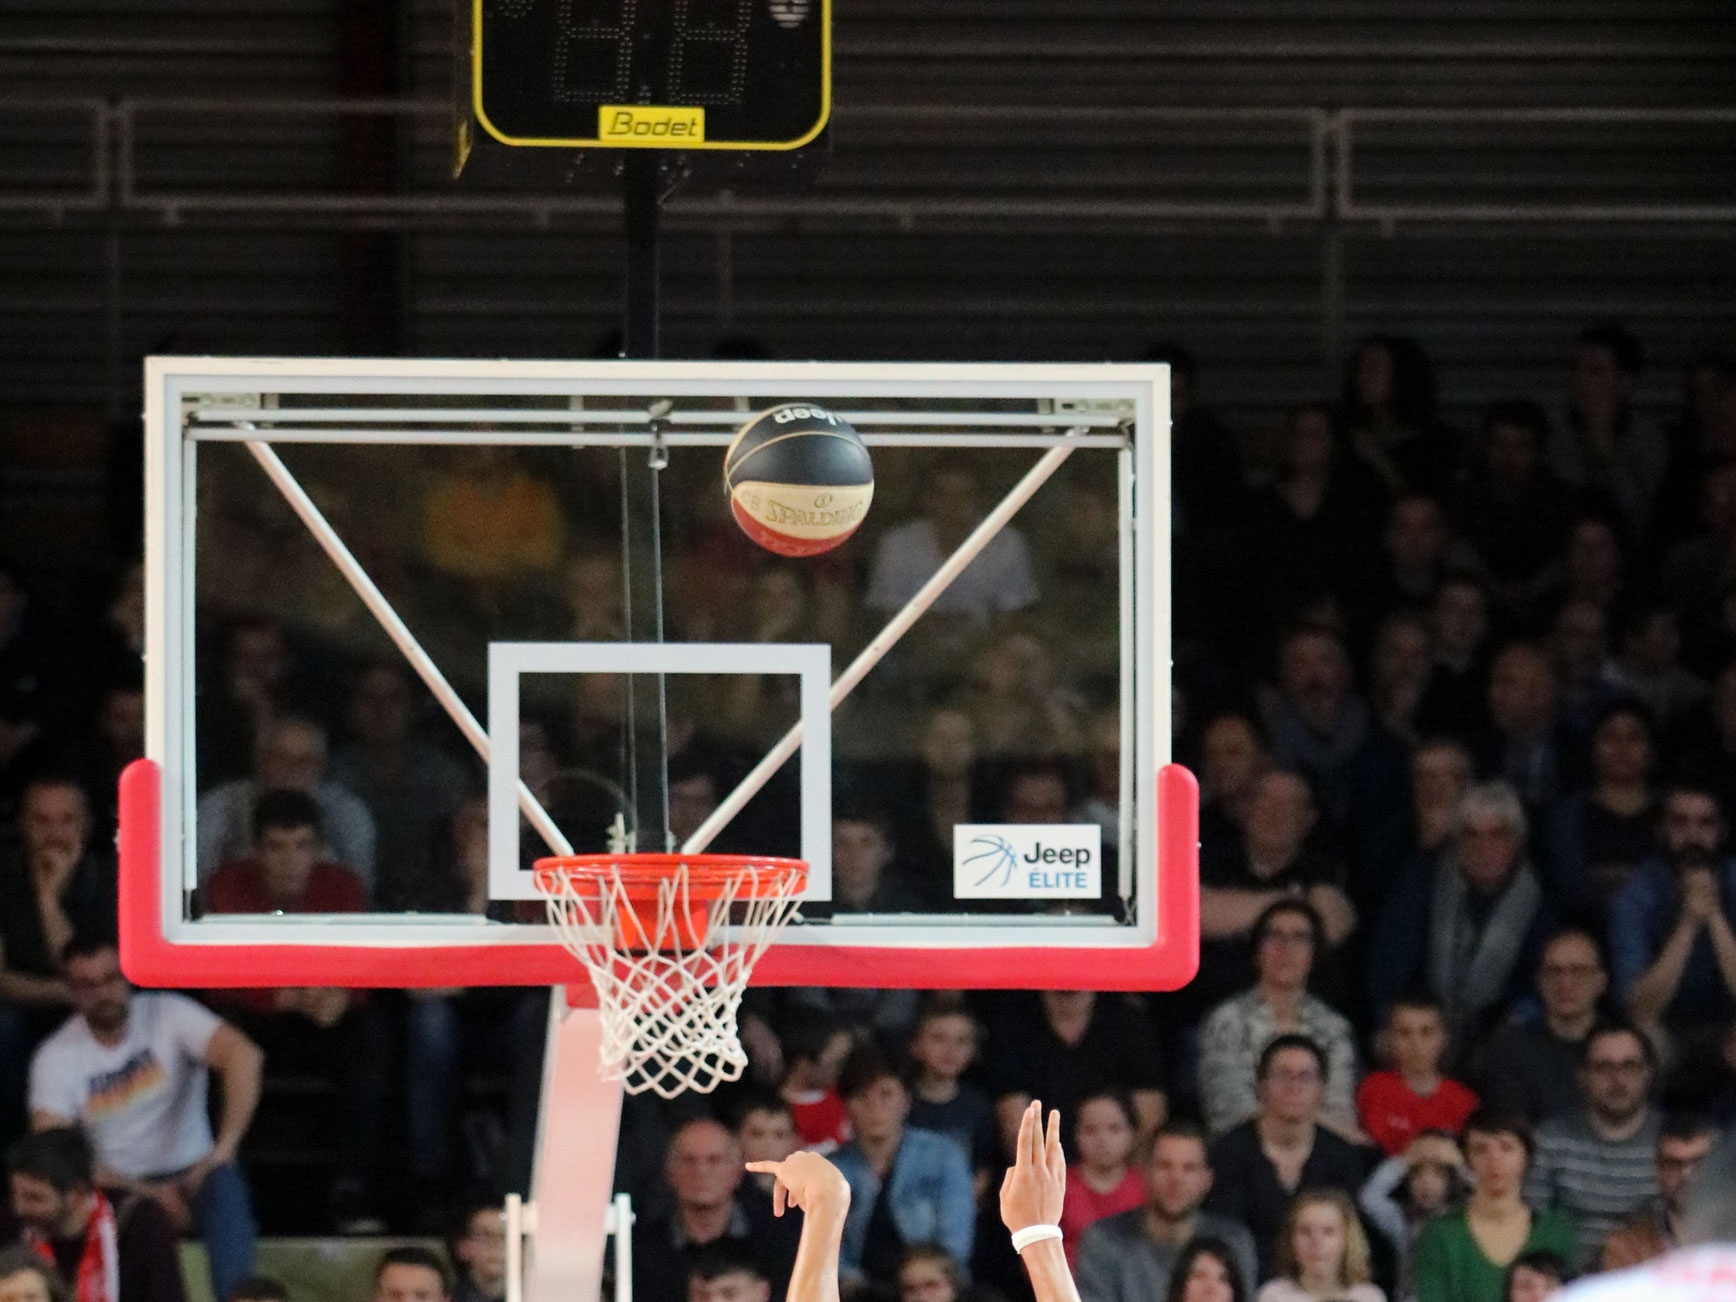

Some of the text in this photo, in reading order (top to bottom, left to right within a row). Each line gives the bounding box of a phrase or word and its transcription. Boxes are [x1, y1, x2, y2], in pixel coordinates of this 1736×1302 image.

[607, 111, 698, 137] Bodet
[1024, 842, 1090, 868] Jeep
[1029, 868, 1087, 888] ÉLITE
